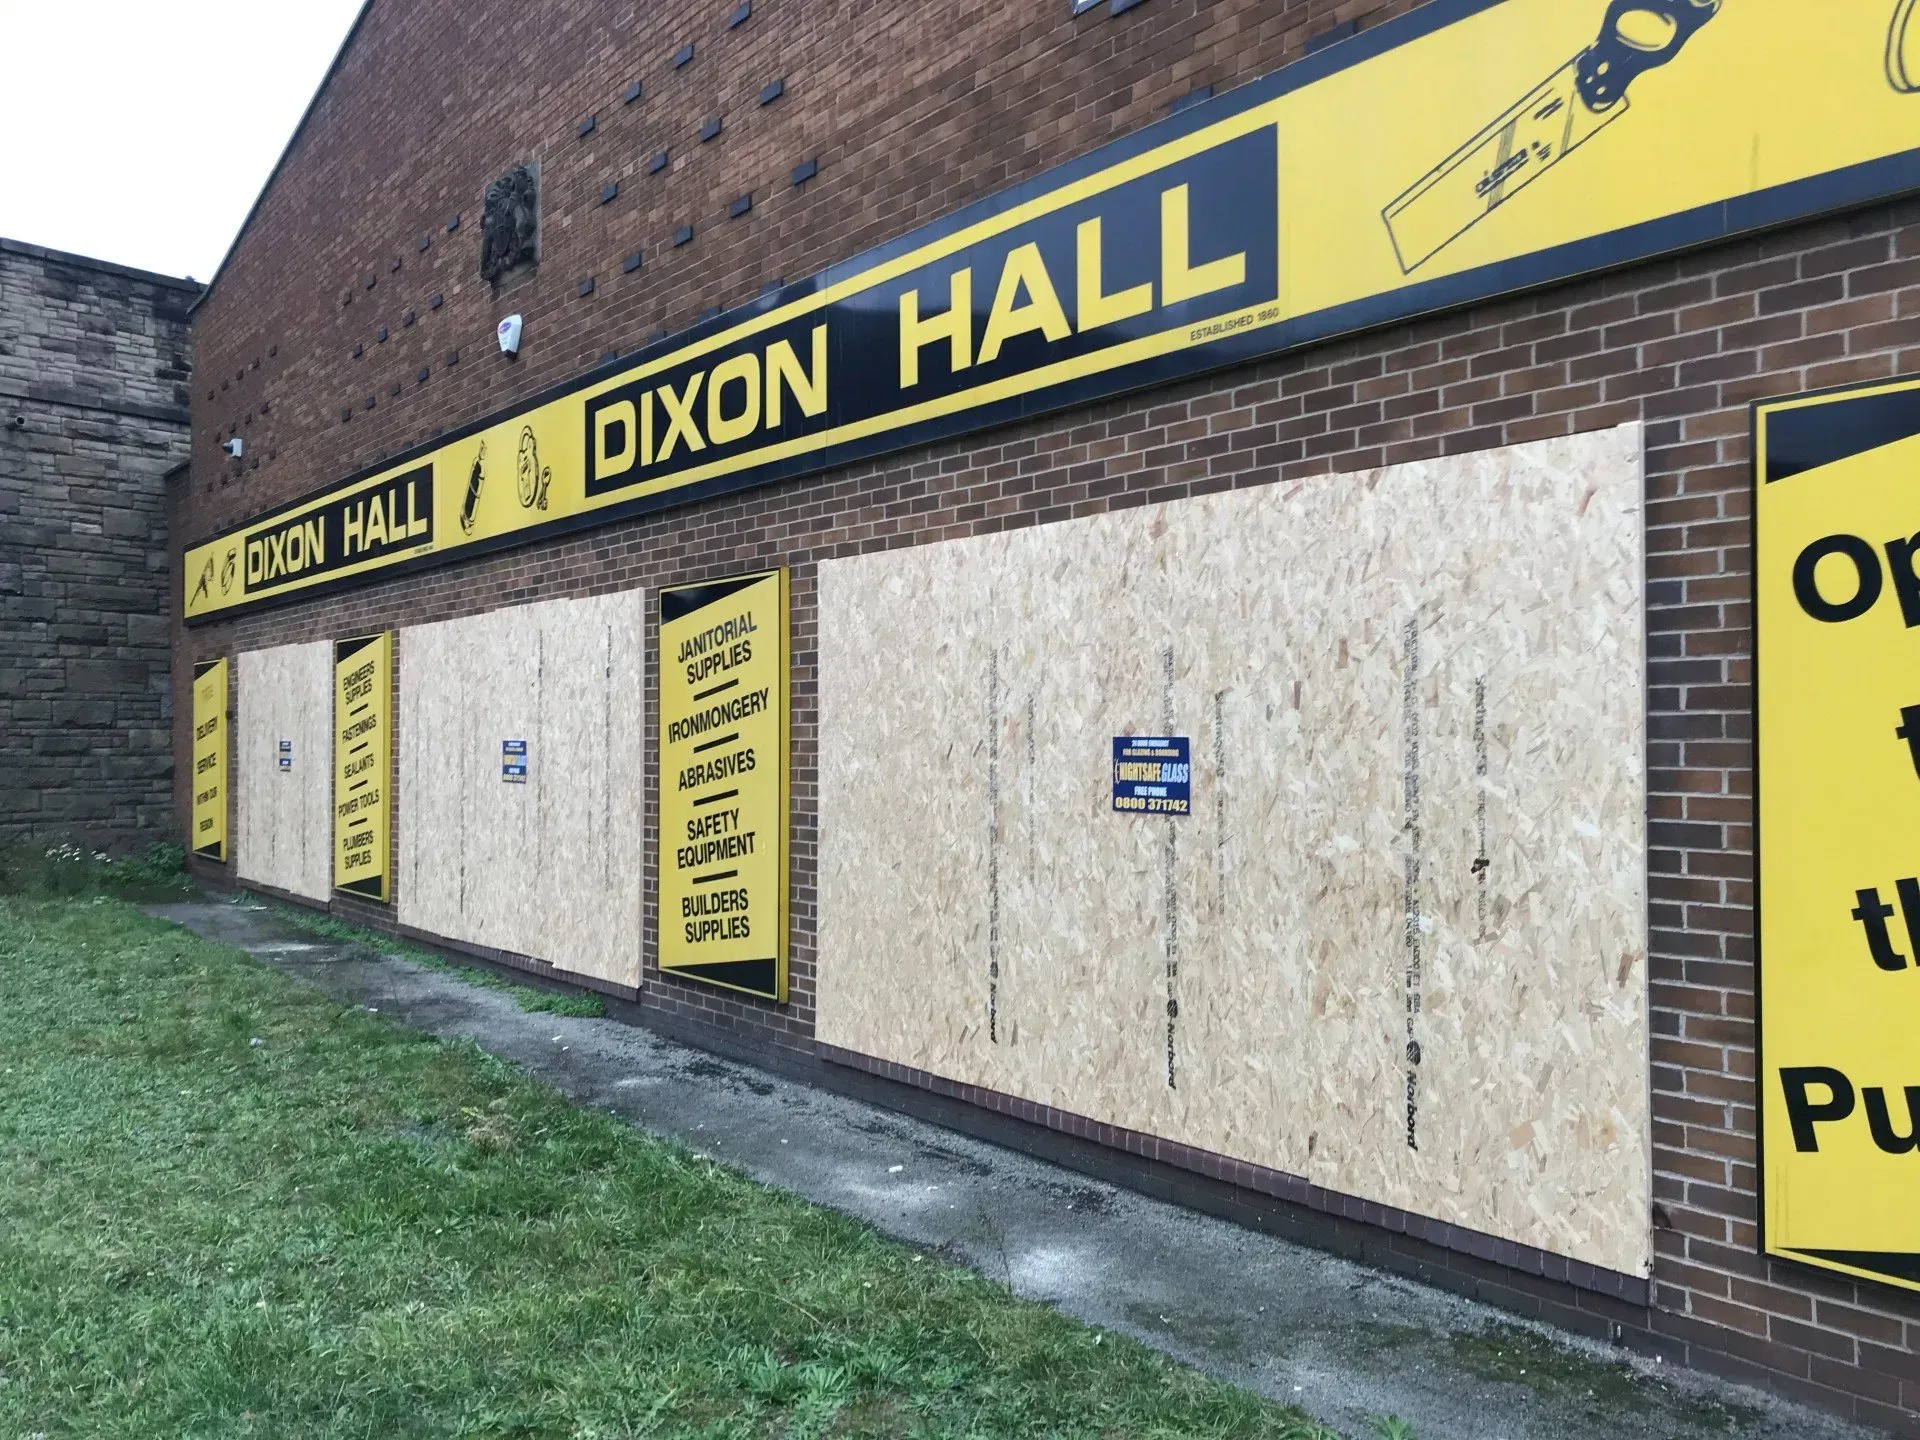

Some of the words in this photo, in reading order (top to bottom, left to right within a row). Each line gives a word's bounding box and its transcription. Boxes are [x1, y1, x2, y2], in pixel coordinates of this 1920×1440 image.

[594, 324, 828, 481] DIXON
[900, 183, 1246, 389] HALL
[1190, 315, 1254, 341] ESTABLISHED
[248, 515, 325, 585] DIXON
[344, 481, 428, 557] HALL
[677, 611, 757, 664] JANITORIAL
[687, 639, 752, 685] SUPPLIES
[668, 687, 769, 744] IRONMONGERY
[678, 749, 756, 791] ABRASIVES
[338, 798, 359, 818] POWER
[360, 788, 380, 810] TOOLS
[1115, 797, 1146, 809] 0800
[687, 808, 740, 841] SAFETY
[345, 849, 372, 870] SUPPLIES
[677, 832, 755, 870] EQUIPMENT
[682, 888, 749, 918] BUILDERS
[685, 916, 750, 944] SUPPLIES
[1406, 1070, 1419, 1152] Norbord
